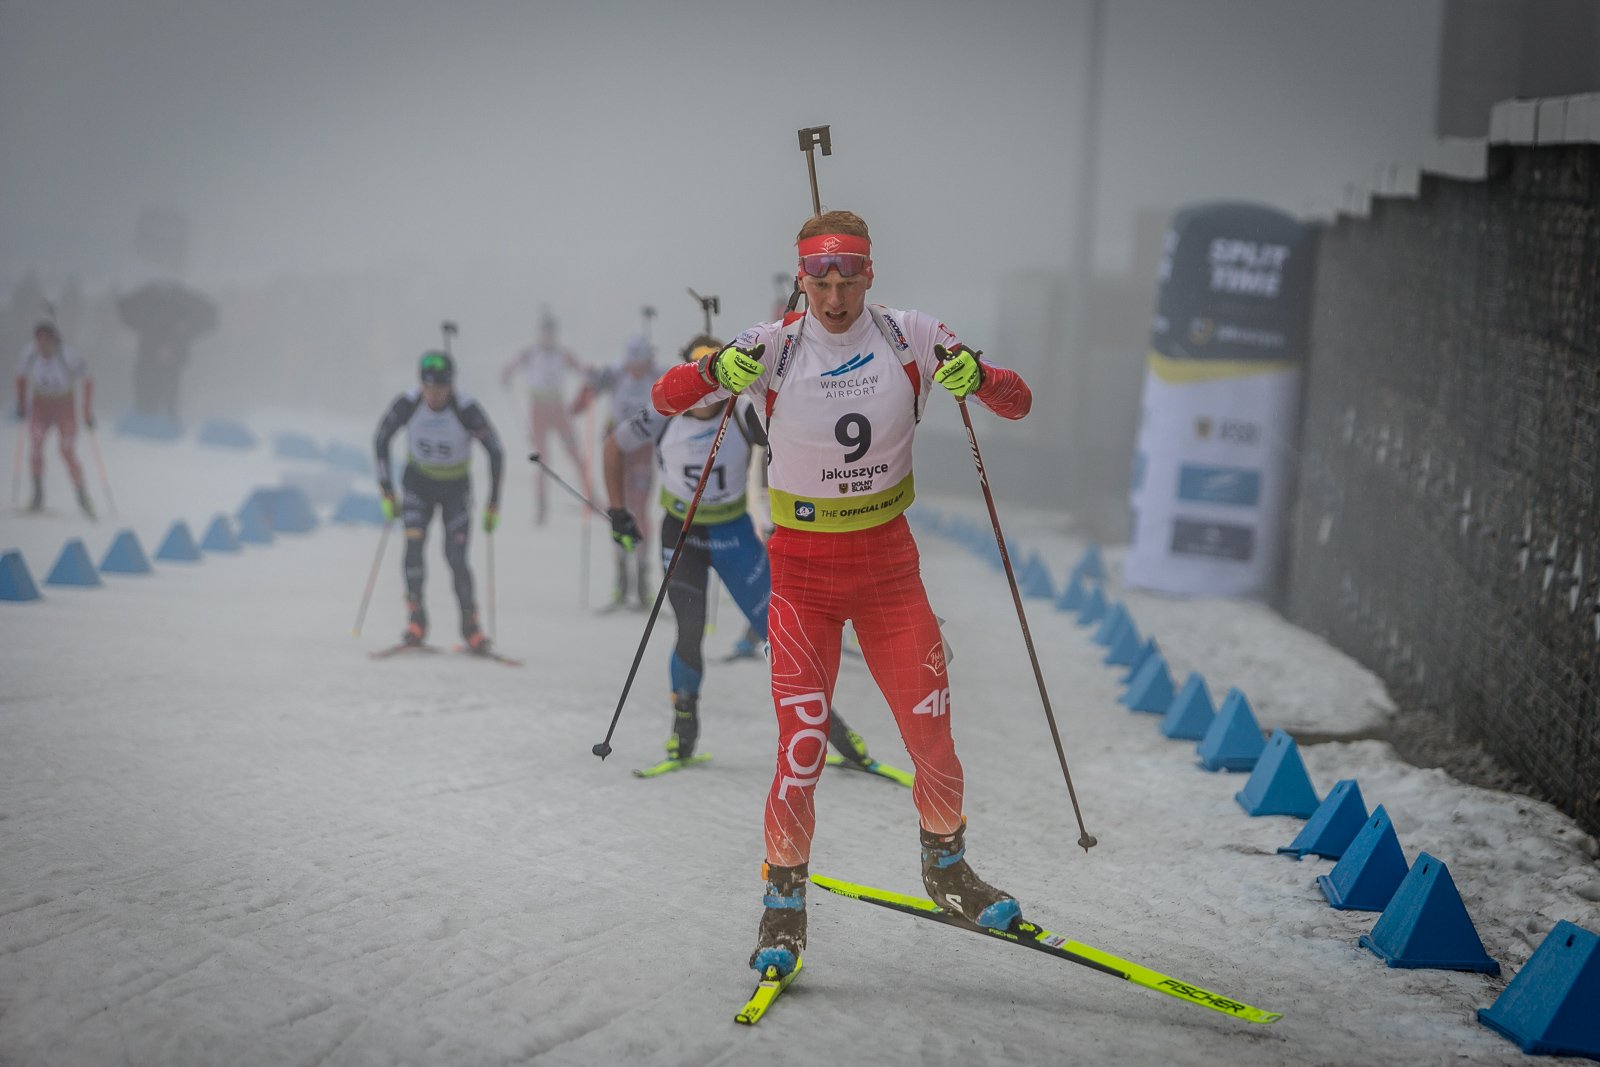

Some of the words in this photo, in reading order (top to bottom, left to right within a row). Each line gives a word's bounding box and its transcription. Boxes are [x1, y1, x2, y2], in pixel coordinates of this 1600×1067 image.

[1210, 237, 1290, 268] SPLIT
[1210, 267, 1280, 297] TIME
[883, 314, 909, 349] INCORSA
[776, 334, 792, 377] INCORSA
[820, 375, 879, 389] WROCLAW
[825, 386, 876, 399] AIRPORT
[834, 412, 872, 464] 9
[684, 464, 726, 492] 51
[821, 464, 889, 482] Jakuszyce
[821, 510, 838, 518] THE
[840, 504, 879, 517] OFFICIAL
[881, 499, 894, 510] IBU
[777, 691, 829, 801] POL
[988, 928, 1018, 941] FISCHER
[1157, 979, 1246, 1013] FISCHER
